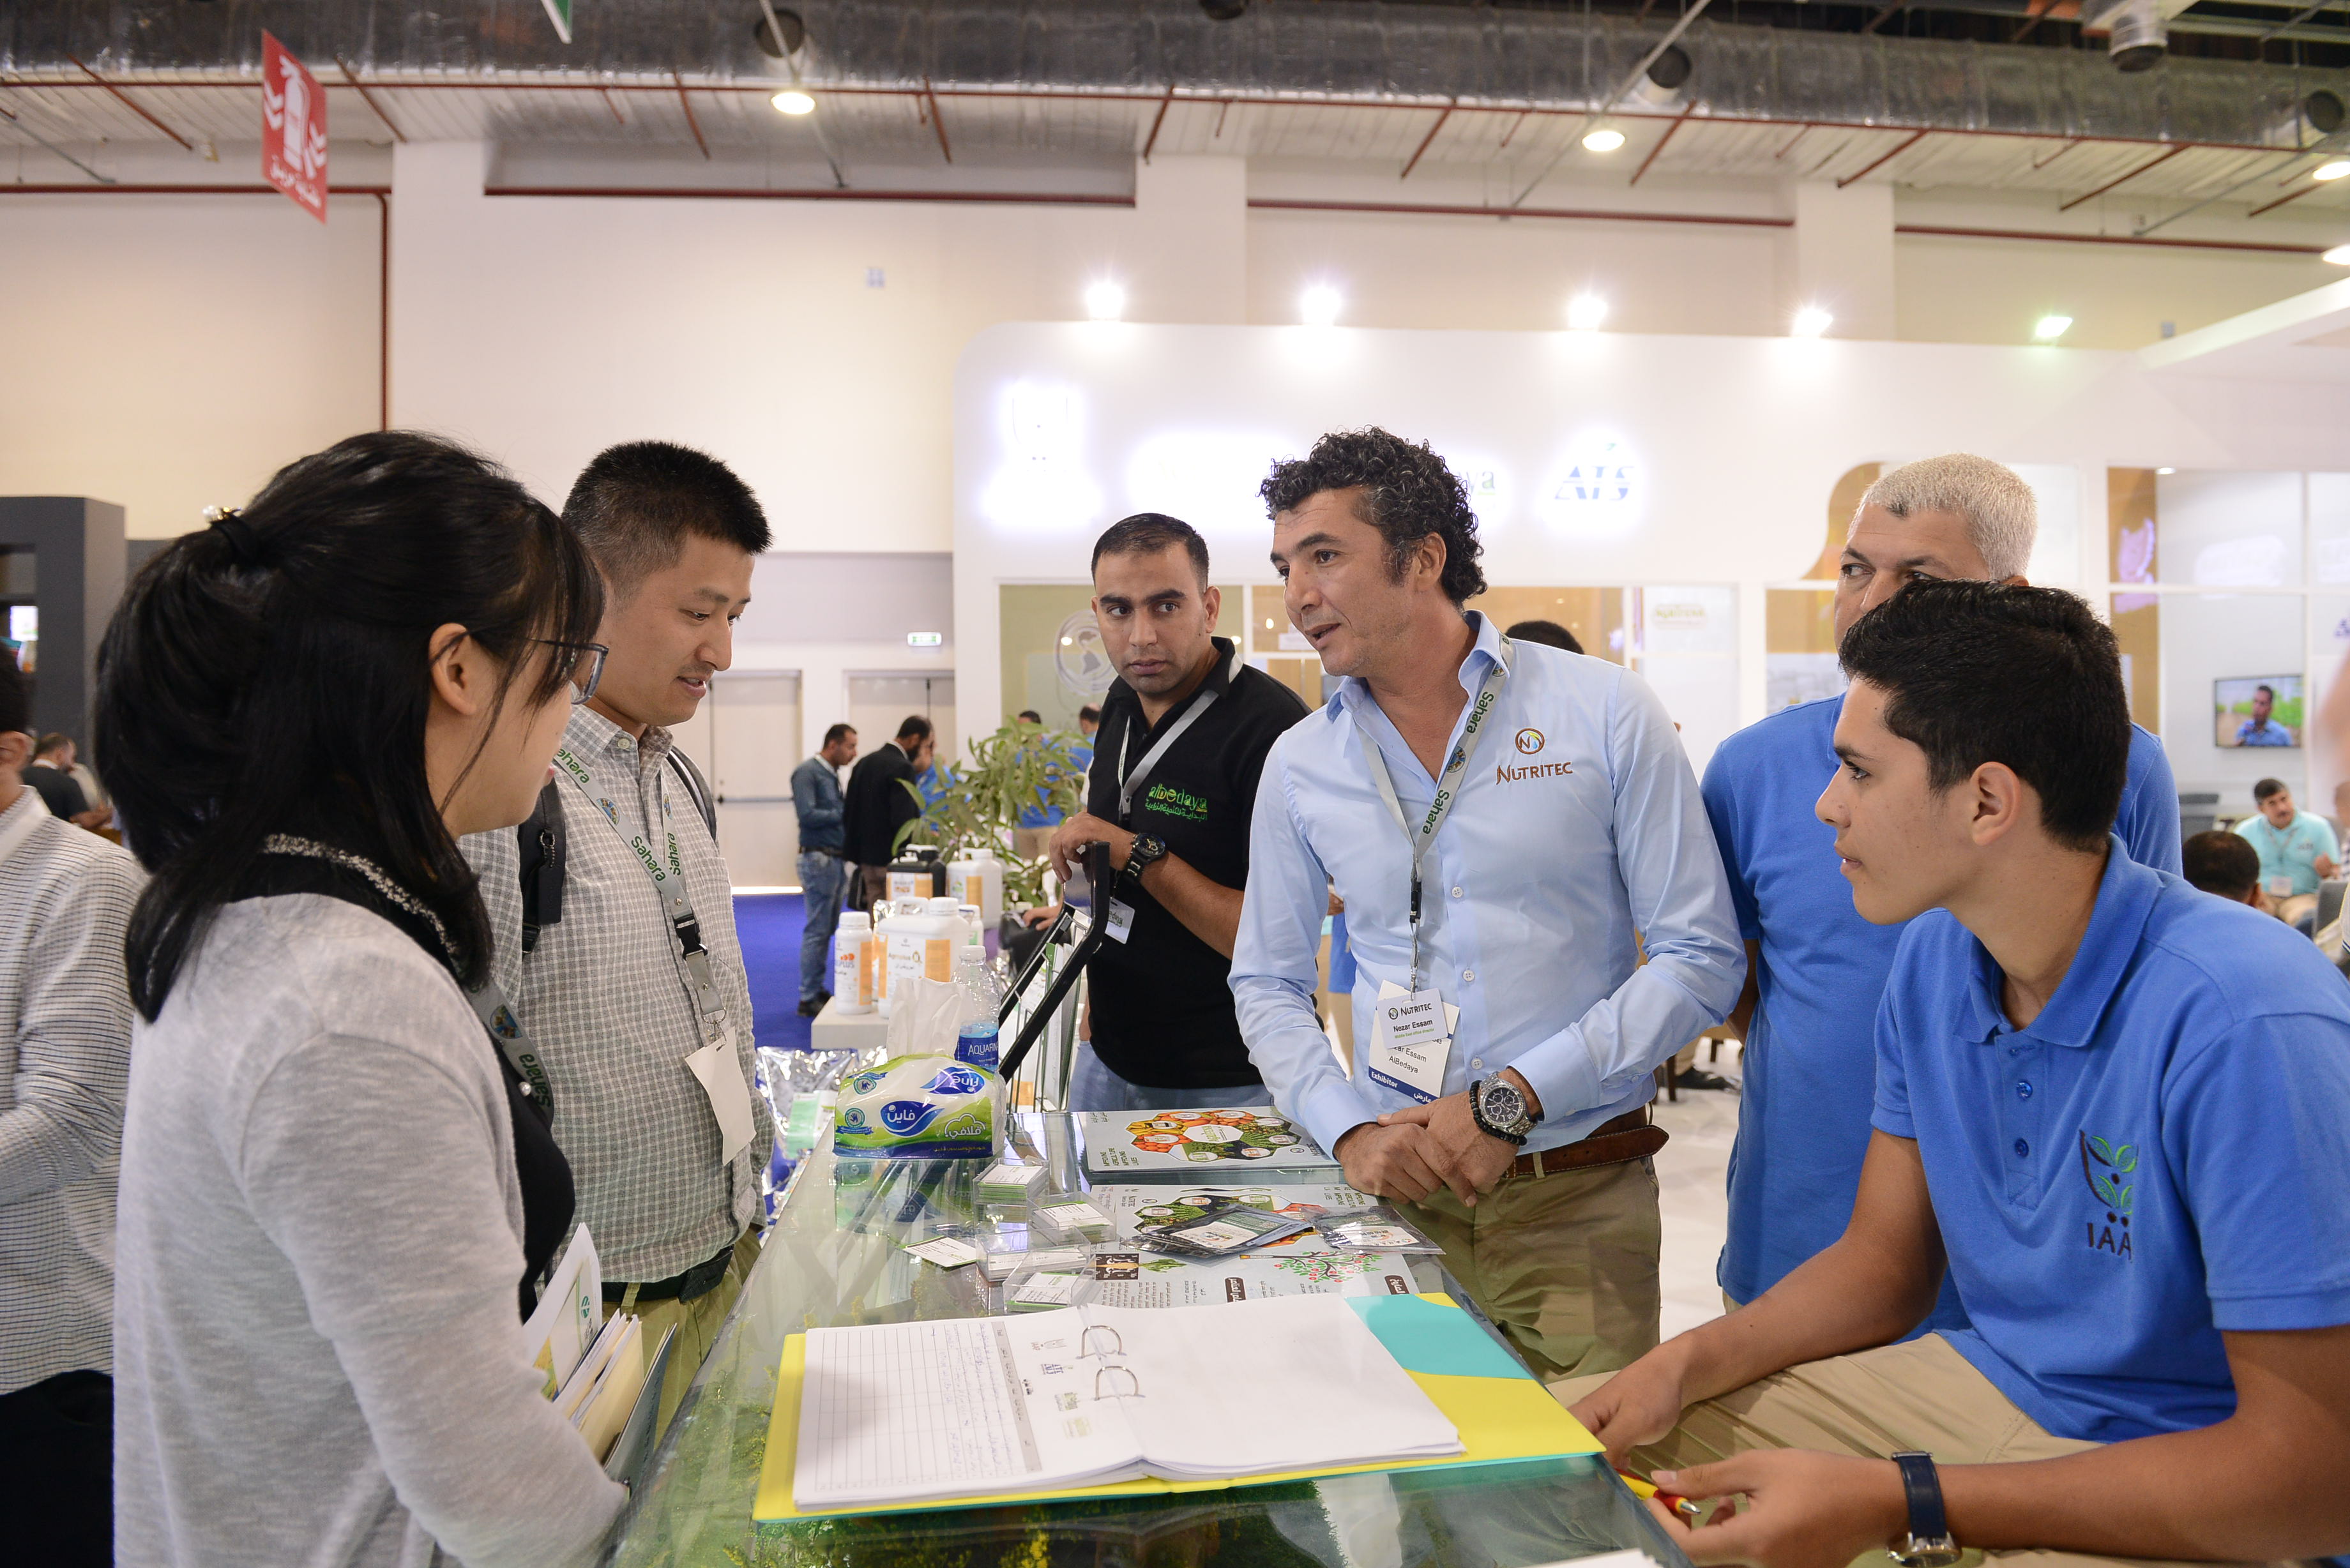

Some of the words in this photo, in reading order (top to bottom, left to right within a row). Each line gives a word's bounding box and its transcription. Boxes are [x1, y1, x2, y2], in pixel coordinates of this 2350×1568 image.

[1466, 691, 1494, 734] Sahara
[556, 748, 590, 784] ahara
[1496, 761, 1573, 785] NUTRITEC
[1148, 783, 1208, 811] albedaya
[1422, 788, 1450, 835] Sahara
[631, 836, 666, 882] Sahara
[667, 832, 688, 877] Sahara
[1393, 1023, 1411, 1032] Nezar
[1412, 1020, 1433, 1029] Essam
[1388, 1055, 1419, 1074] AlBedaya
[1406, 1049, 1427, 1063] Essam
[518, 1053, 552, 1108] Sahara
[1370, 1071, 1399, 1089] Exhibitor
[886, 1104, 916, 1124] فاين
[2086, 1221, 2133, 1261] IAA
